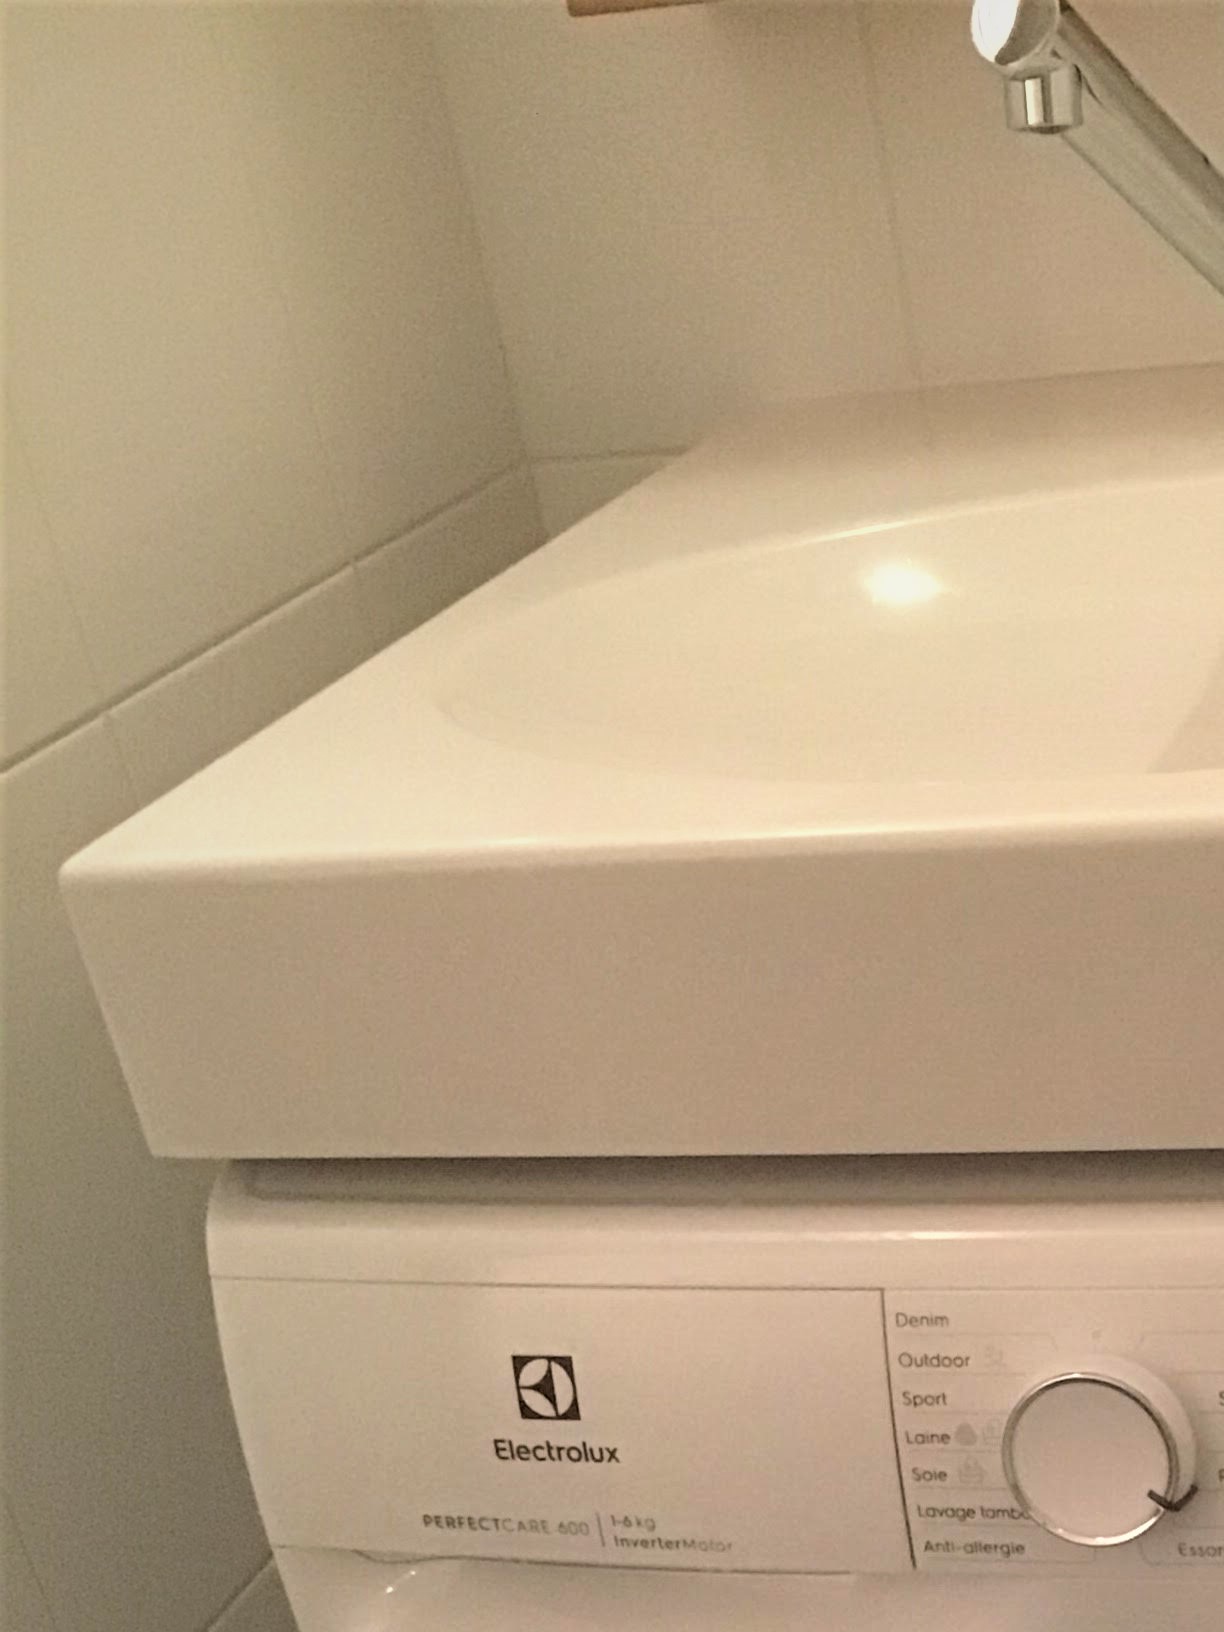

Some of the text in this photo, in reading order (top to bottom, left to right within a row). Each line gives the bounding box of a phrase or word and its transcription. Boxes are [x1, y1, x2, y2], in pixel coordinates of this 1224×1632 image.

[895, 1312, 949, 1328] Denim
[897, 1352, 970, 1368] Outdoor
[902, 1391, 947, 1407] Sport
[905, 1431, 951, 1446] Laine
[493, 1438, 621, 1464] Electrolux
[912, 1467, 948, 1482] Soie
[917, 1505, 977, 1522] Lavage
[422, 1514, 590, 1537] PERFECTCARE 600
[613, 1535, 733, 1553] InverterMotor
[924, 1540, 1026, 1556] Anti-allergie
